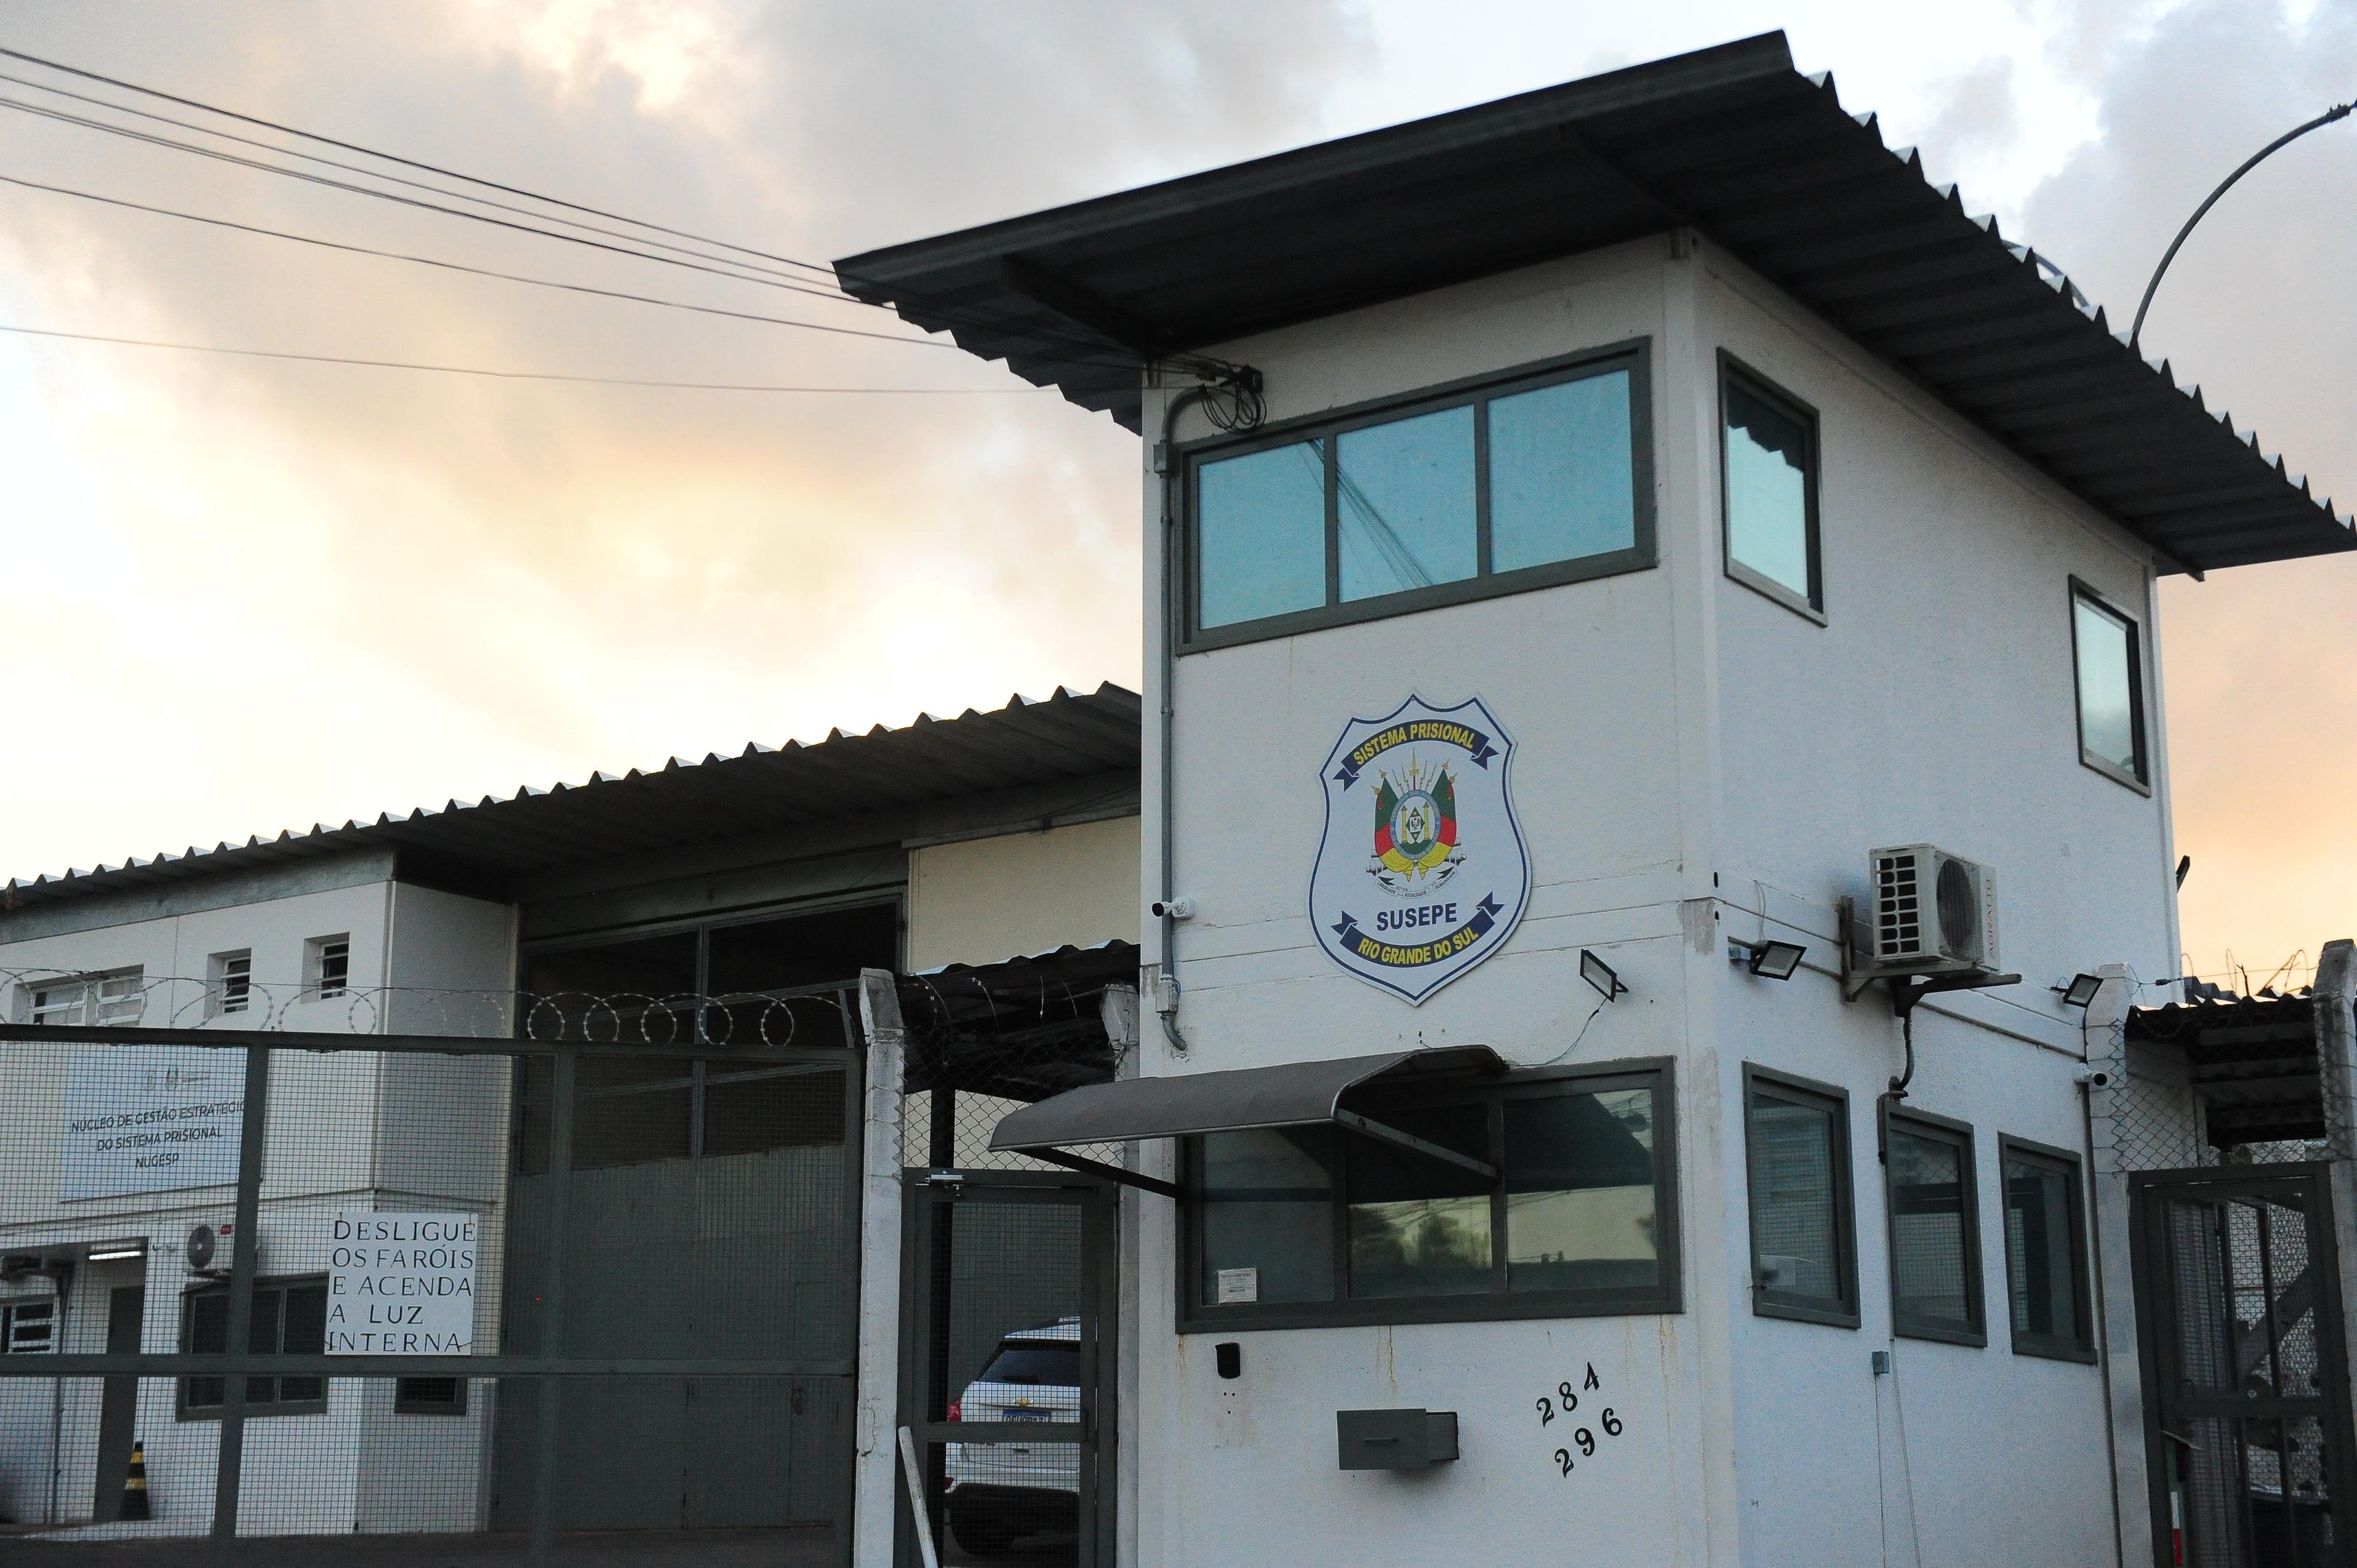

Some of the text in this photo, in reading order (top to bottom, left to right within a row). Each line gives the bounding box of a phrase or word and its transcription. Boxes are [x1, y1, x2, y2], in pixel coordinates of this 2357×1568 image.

[1353, 722, 1475, 765] SISTEMA PRISIONAL
[1376, 902, 1458, 931] SUSEPE
[1357, 927, 1479, 965] RIO GRANDE DO SUL
[72, 1100, 245, 1132] NÚCLEO DE GESTÃO ESTRATÉGIC
[97, 1126, 223, 1151] DO SISTEMA PRISIONAL
[135, 1153, 179, 1169] NUGESP
[333, 1220, 476, 1242] DESLIGUE
[332, 1244, 473, 1269] OS FARÓIS
[333, 1275, 472, 1297] E ACENDA
[329, 1304, 423, 1324] A LUZ
[327, 1331, 461, 1352] INTERNA
[1536, 1361, 1600, 1428] 284
[1554, 1408, 1622, 1479] 296
